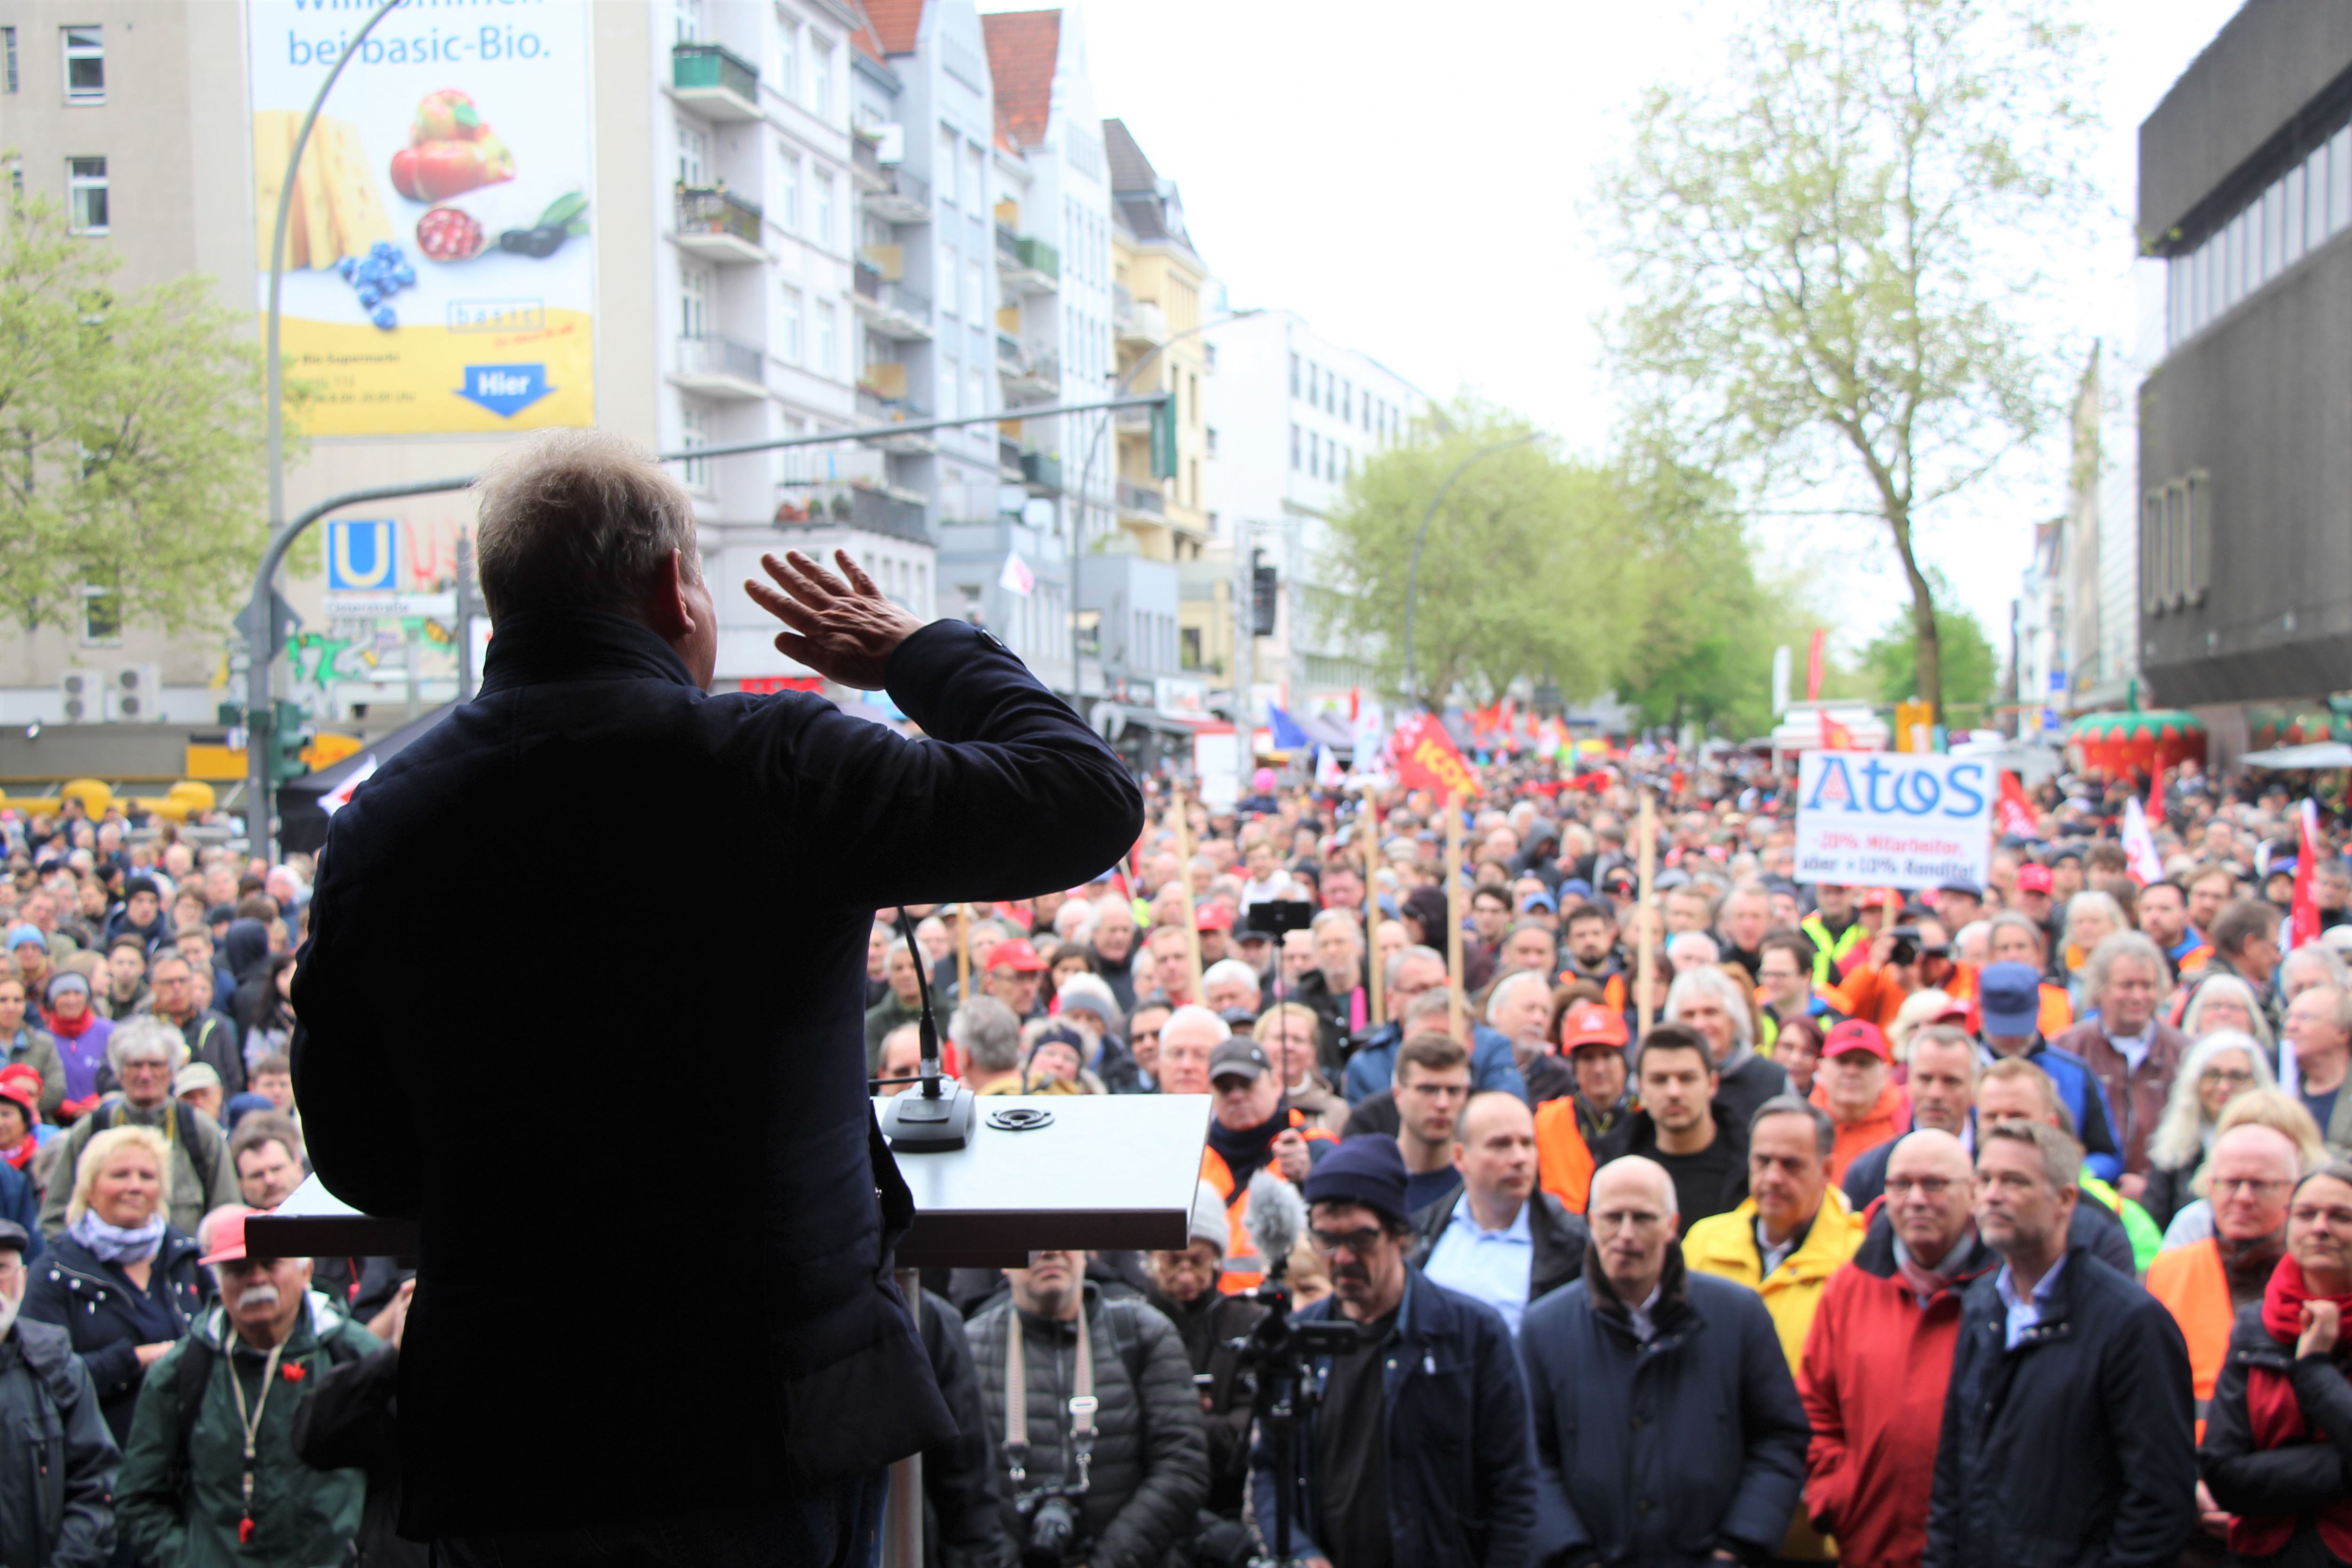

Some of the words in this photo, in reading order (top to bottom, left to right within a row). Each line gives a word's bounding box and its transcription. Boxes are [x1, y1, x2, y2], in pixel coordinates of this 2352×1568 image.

[288, 30, 347, 65] bei
[362, 25, 550, 64] basic-Bio.
[478, 372, 531, 397] Hier
[335, 523, 389, 587] U
[1804, 757, 1984, 818] Atos
